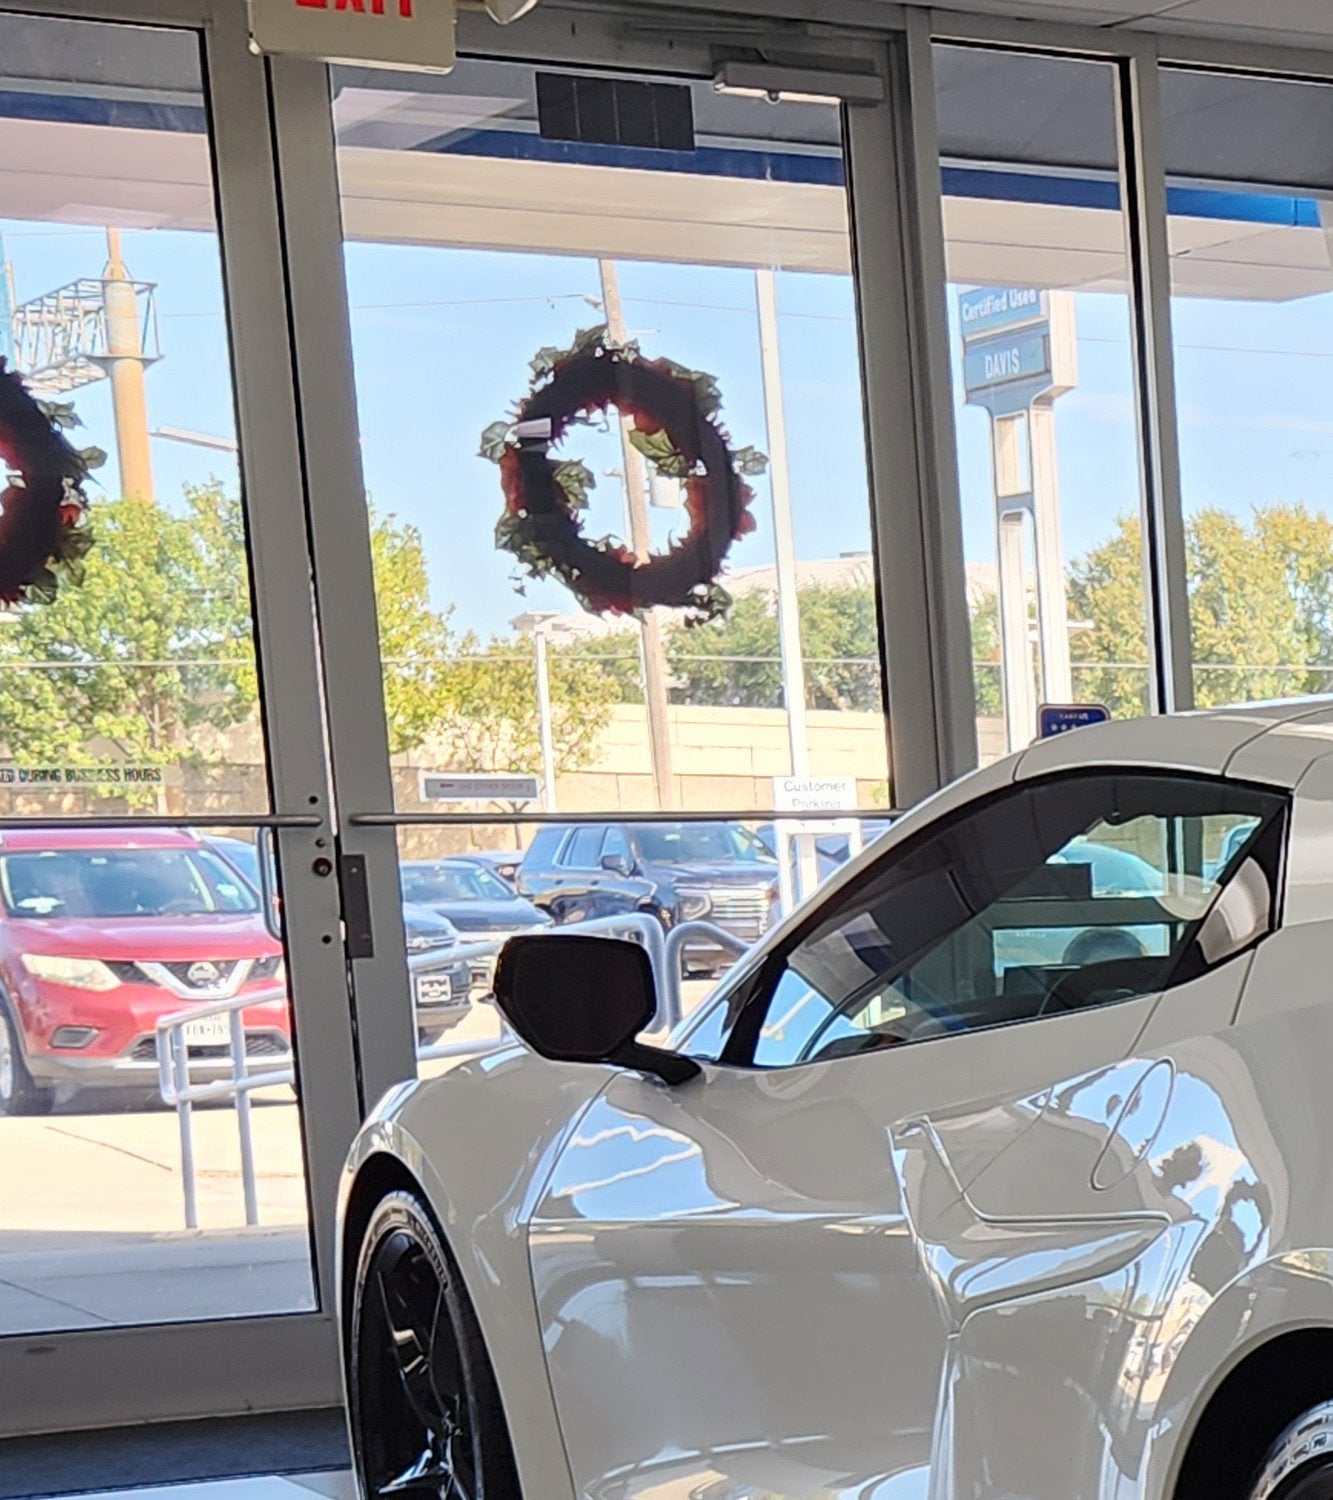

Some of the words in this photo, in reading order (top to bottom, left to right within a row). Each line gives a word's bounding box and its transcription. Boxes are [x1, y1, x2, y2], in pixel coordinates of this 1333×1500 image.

[962, 293, 1008, 322] Certified
[985, 348, 1020, 379] DAVIS
[124, 768, 161, 783] HOURS
[784, 780, 846, 792] Customer
